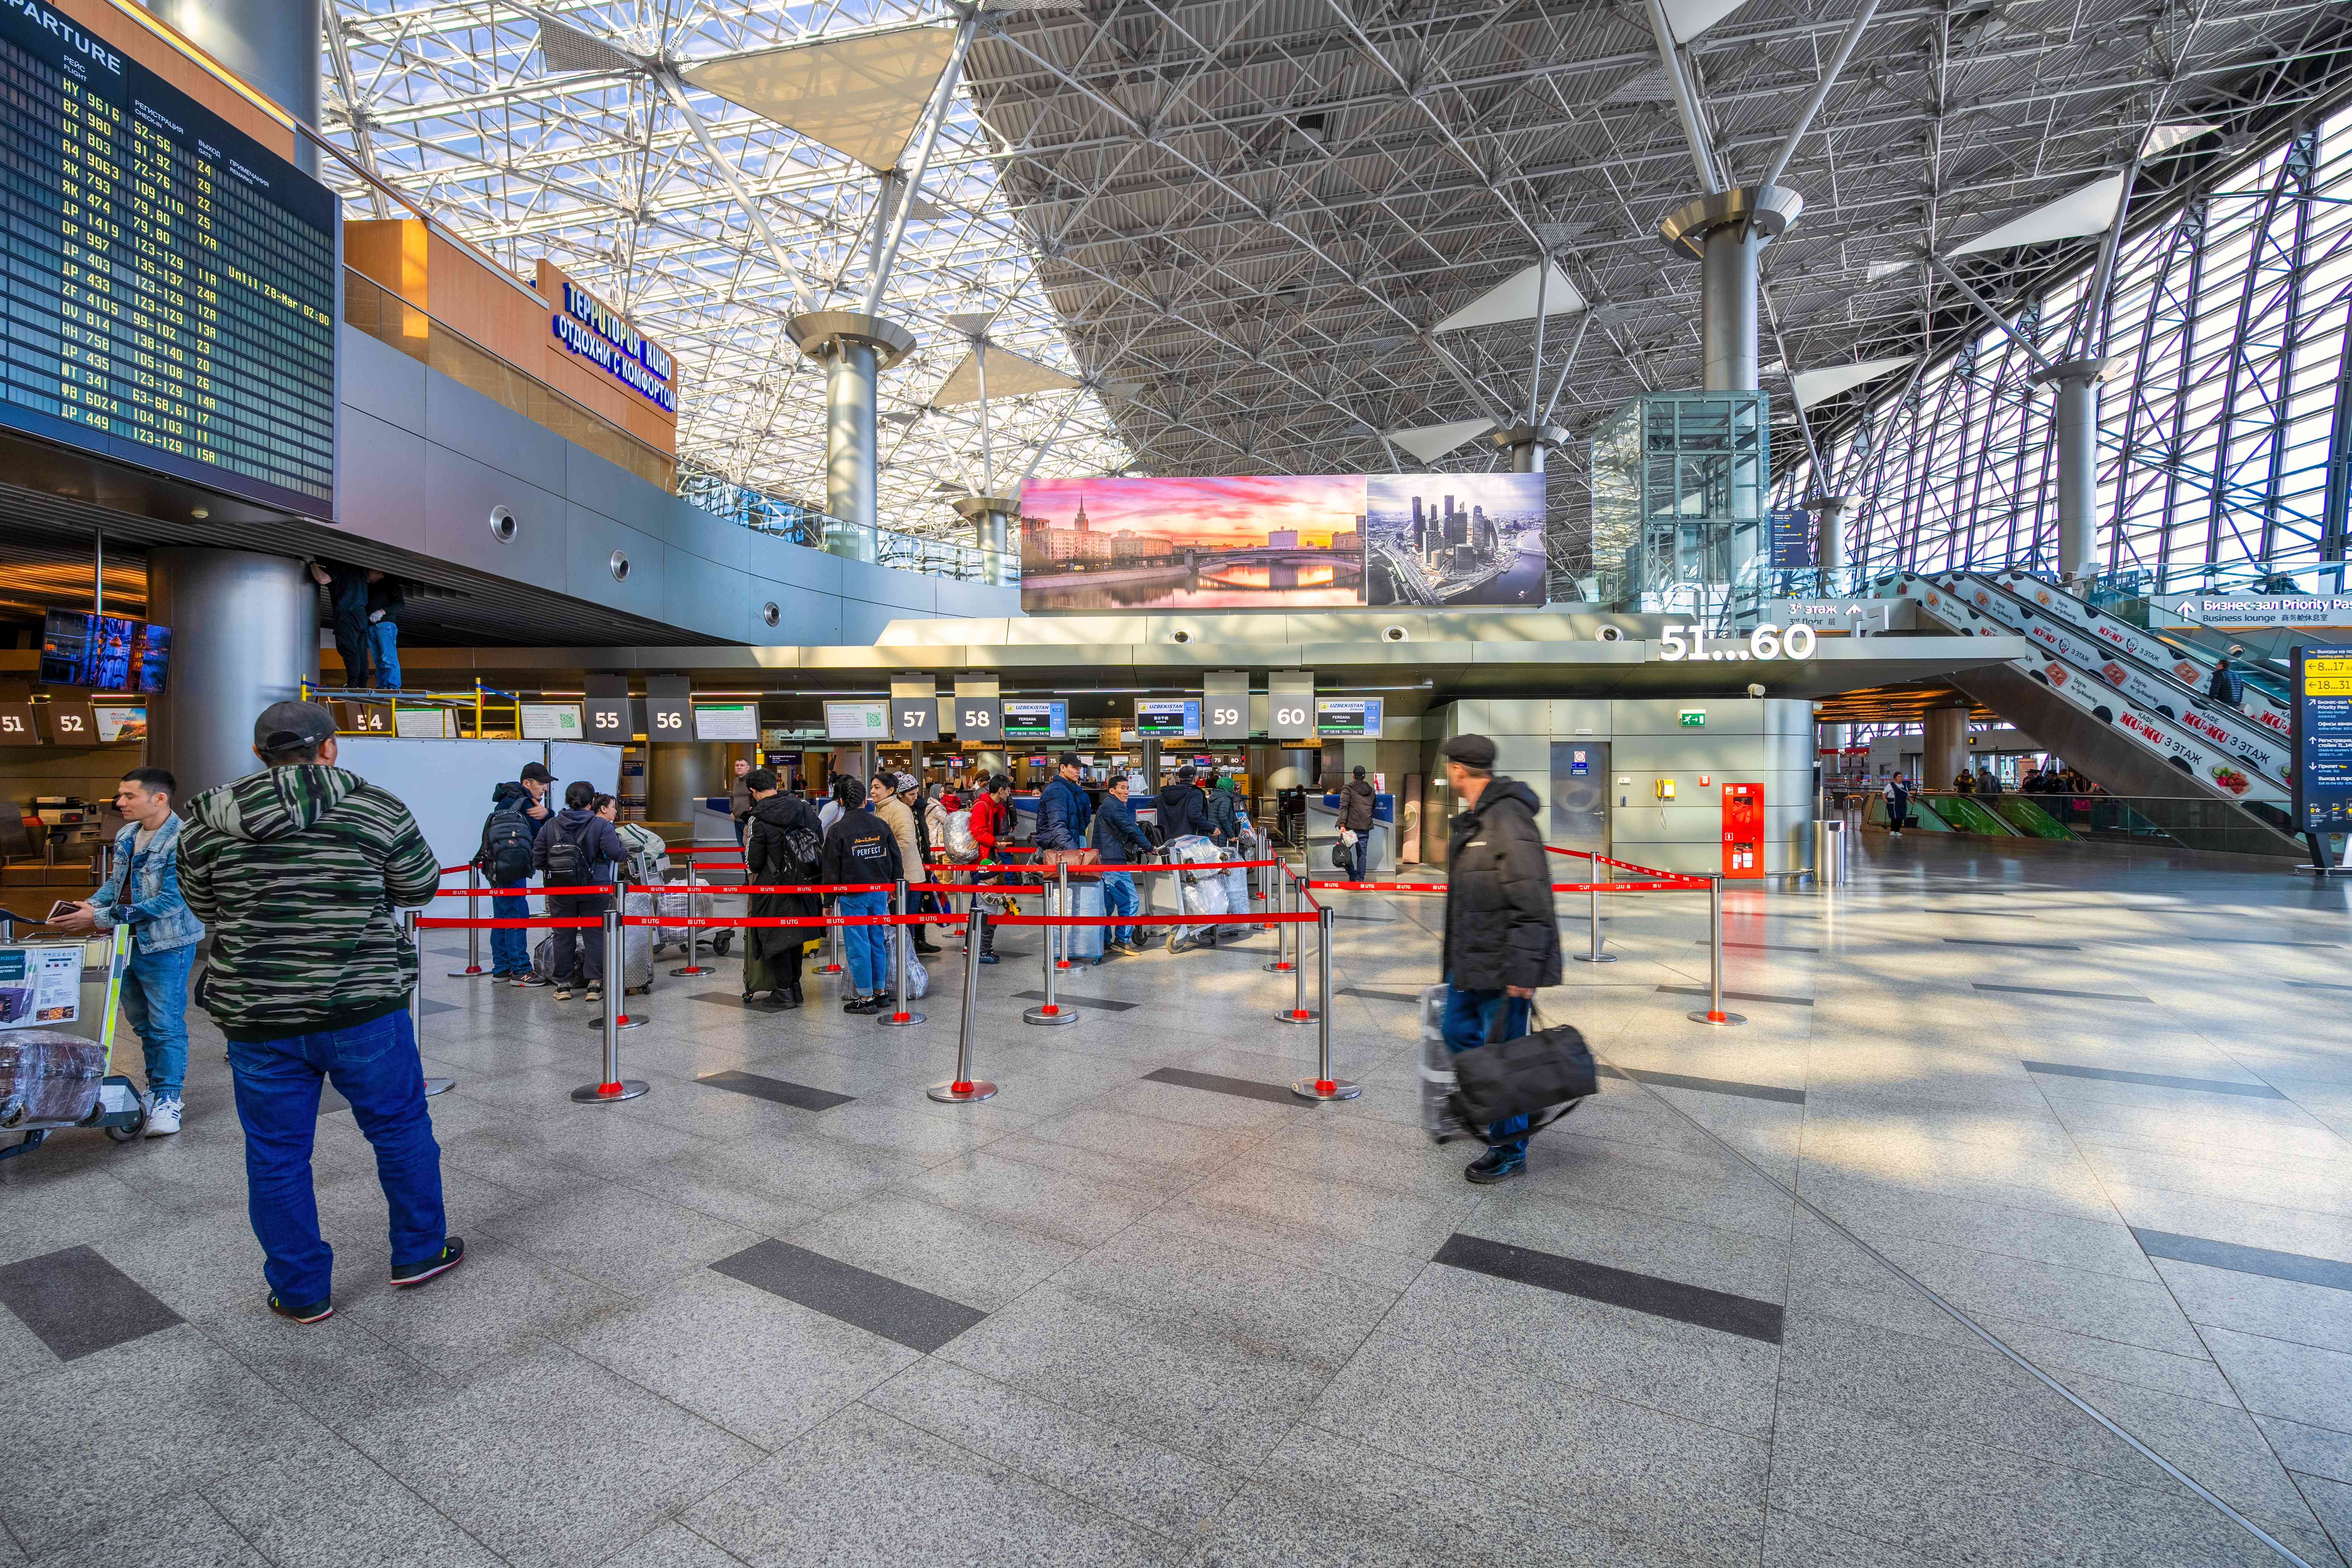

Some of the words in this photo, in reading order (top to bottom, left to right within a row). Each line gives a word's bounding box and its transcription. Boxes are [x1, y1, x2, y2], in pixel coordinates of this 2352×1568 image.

[64, 55, 86, 72] РЕЙС
[64, 64, 87, 81] FLIGHT
[135, 100, 184, 134] РЕГИСТРАЦИЯ
[135, 109, 162, 129] CHECK-IN
[88, 93, 119, 121] 9616
[135, 121, 170, 152] 52-56
[198, 160, 210, 176] 24
[88, 113, 111, 136] 980
[198, 178, 210, 194] 29
[198, 139, 220, 159] ВЫХОД
[198, 148, 212, 159] GATE
[88, 133, 110, 155] 803
[135, 160, 170, 189] 72-76
[198, 196, 210, 211] 22
[230, 159, 269, 187] ПРИМЕЧАНИЯ
[230, 167, 253, 184] REMARKS
[87, 153, 119, 179] 9063
[198, 214, 210, 230] 25
[87, 172, 110, 194] 793
[199, 232, 216, 251] 17A
[88, 213, 118, 238] 1419
[136, 237, 183, 270] 123-129
[199, 268, 216, 285] 11A
[87, 193, 110, 214] 474
[228, 265, 258, 289] Until
[264, 284, 298, 309] 28-Mar
[304, 305, 329, 326] 02:00
[87, 232, 109, 251] 997
[136, 256, 183, 286] 135-137
[197, 285, 216, 304] 24A
[88, 254, 110, 273] 403
[136, 276, 183, 306] 123-129
[199, 304, 216, 320] 12A
[87, 273, 110, 292] 433
[135, 294, 183, 325] 123-129
[198, 322, 216, 339] 13A
[88, 294, 118, 315] 4105
[134, 312, 176, 340] 99-102
[197, 339, 210, 354] 23
[87, 313, 109, 332] 814
[135, 332, 182, 361] 138-140
[197, 357, 209, 372] 20
[87, 333, 109, 351] 758
[135, 352, 182, 379] 105-108
[197, 375, 209, 390] 26
[559, 314, 611, 368] ОТДОХНИ
[614, 353, 620, 374] С
[623, 357, 676, 412] КОМФОРТОМ
[87, 354, 109, 370] 435
[135, 371, 182, 398] 123-129
[198, 394, 215, 409] 14A
[87, 374, 107, 389] 341
[198, 412, 209, 424] 17
[86, 392, 117, 412] 6024
[197, 430, 207, 443] 11
[87, 413, 109, 429] 449
[135, 428, 182, 453] 123-129
[198, 448, 215, 463] 15A
[1804, 605, 1837, 614] этаж
[1945, 600, 1954, 610] Вкусно
[1995, 600, 2005, 610] Вкусно
[2057, 599, 2068, 609] Вкусно
[2203, 600, 2278, 610] Бизнес-зал
[2282, 599, 2329, 612] Priority
[2245, 614, 2275, 623] lounge
[1660, 624, 1816, 661] 51...60
[2076, 651, 2090, 663] ЭТАЖ
[2145, 650, 2160, 662] ЭТАЖ
[2318, 662, 2344, 671] 8...17
[2074, 677, 2087, 689] Вкусно
[2133, 676, 2147, 688] Вкусно
[2318, 681, 2350, 689] 18...31
[2070, 684, 2099, 706] по-домашнему
[2130, 684, 2158, 706] по-домашнему
[3, 716, 24, 732] 51
[61, 715, 84, 731] 52
[357, 714, 383, 730] 54
[596, 712, 619, 729] 55
[657, 712, 682, 729] 56
[903, 711, 926, 727] 57
[965, 711, 990, 727] 58
[1213, 709, 1239, 726] 59
[1277, 708, 1305, 725] 60
[2138, 712, 2154, 725] КАФЕ
[2202, 711, 2219, 724] КАФЕ
[2165, 737, 2171, 746] 3
[2172, 741, 2202, 765] ЭТАЖ
[2230, 737, 2237, 746] 3
[2238, 740, 2270, 765] ЭТАЖ
[857, 846, 880, 856] PERFECT
